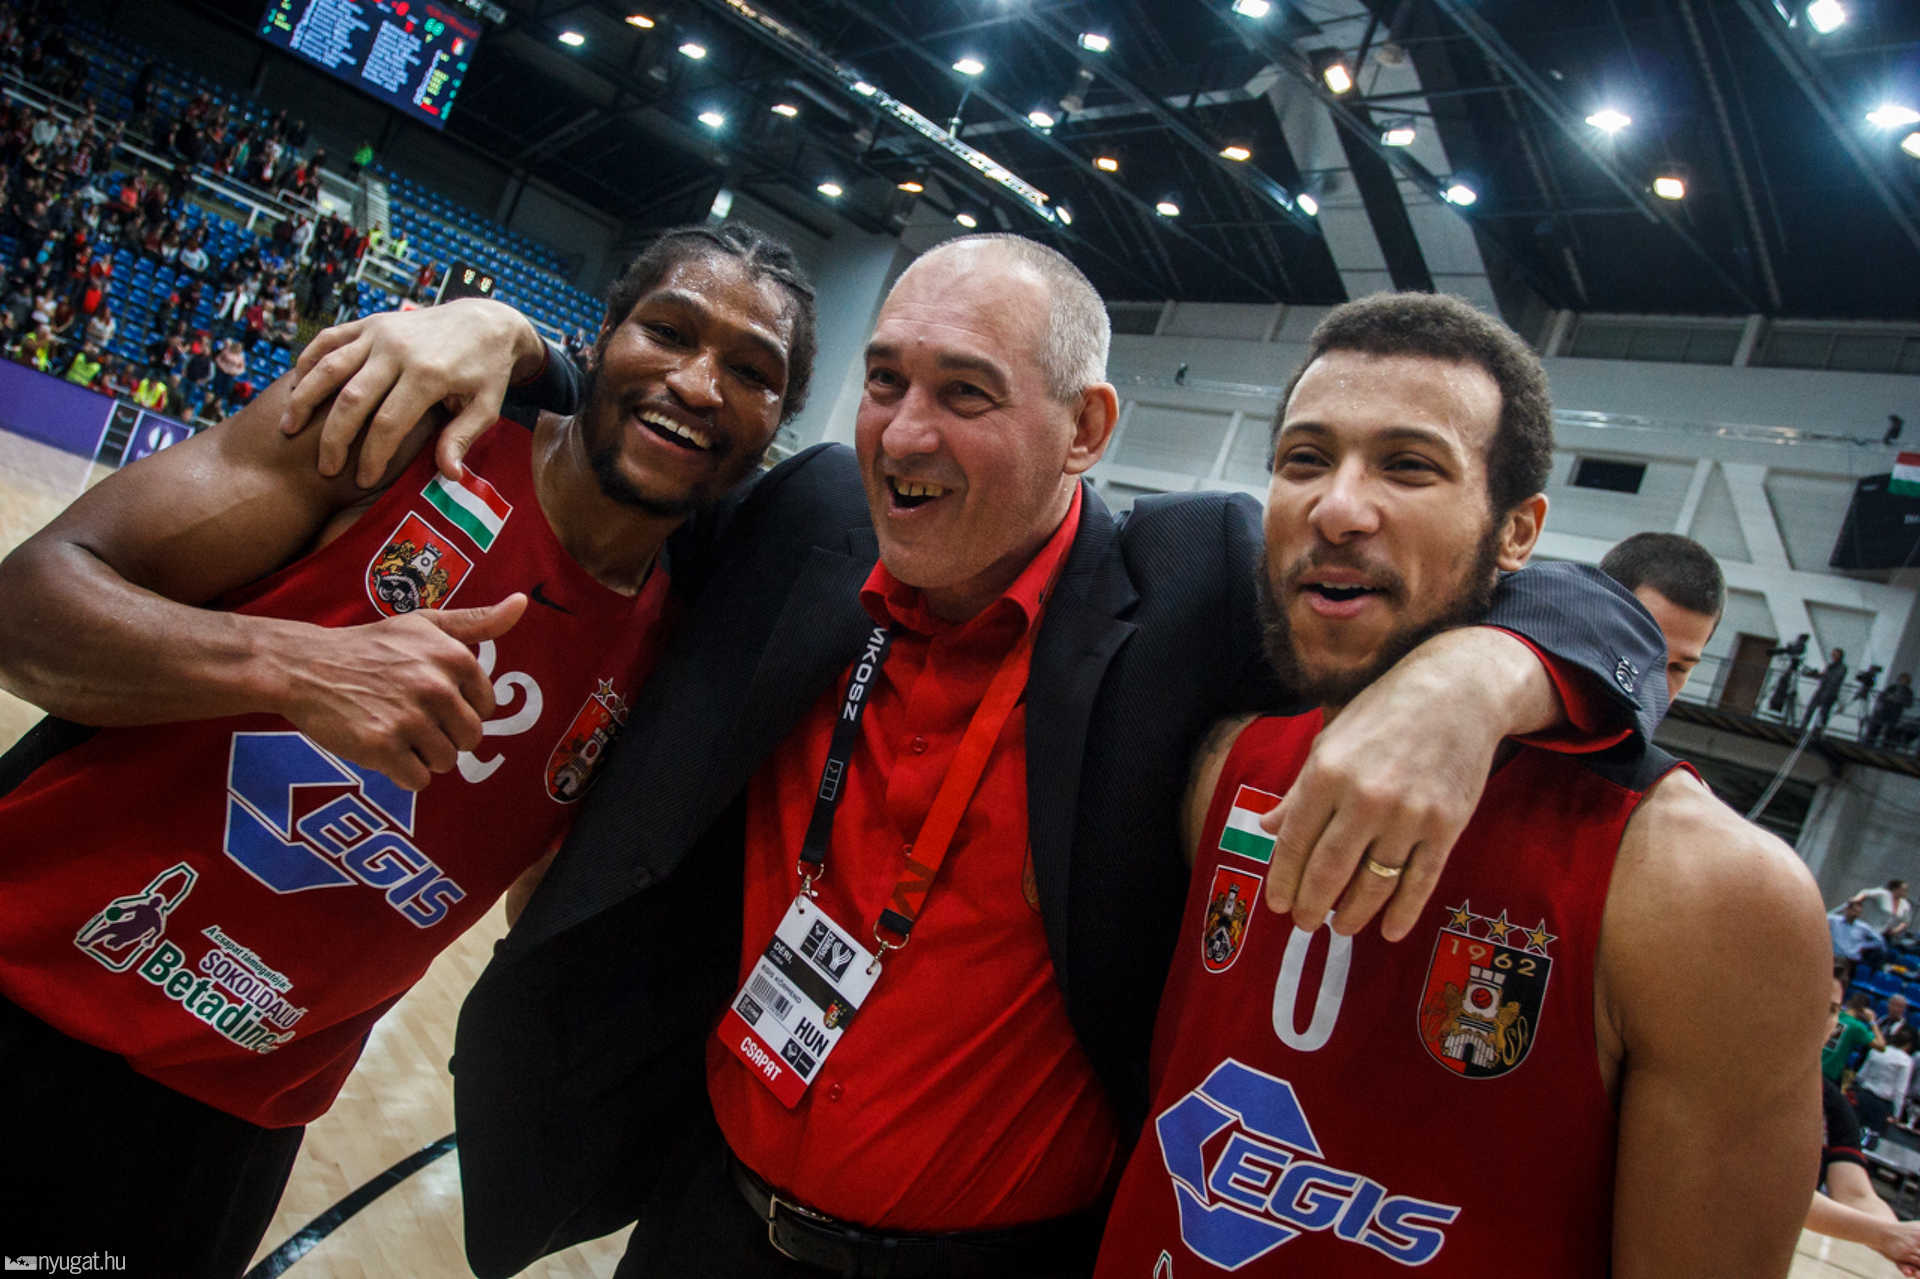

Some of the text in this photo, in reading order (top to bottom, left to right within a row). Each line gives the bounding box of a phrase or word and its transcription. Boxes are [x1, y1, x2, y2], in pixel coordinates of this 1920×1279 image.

[457, 640, 543, 784] 2
[296, 792, 467, 929] EGIS
[201, 949, 307, 1029] SOKOLDALÚ
[1450, 937, 1537, 977] 1962
[740, 1036, 782, 1081] CSAPAT
[794, 1017, 830, 1058] HUN
[1208, 1131, 1462, 1267] EGIS
